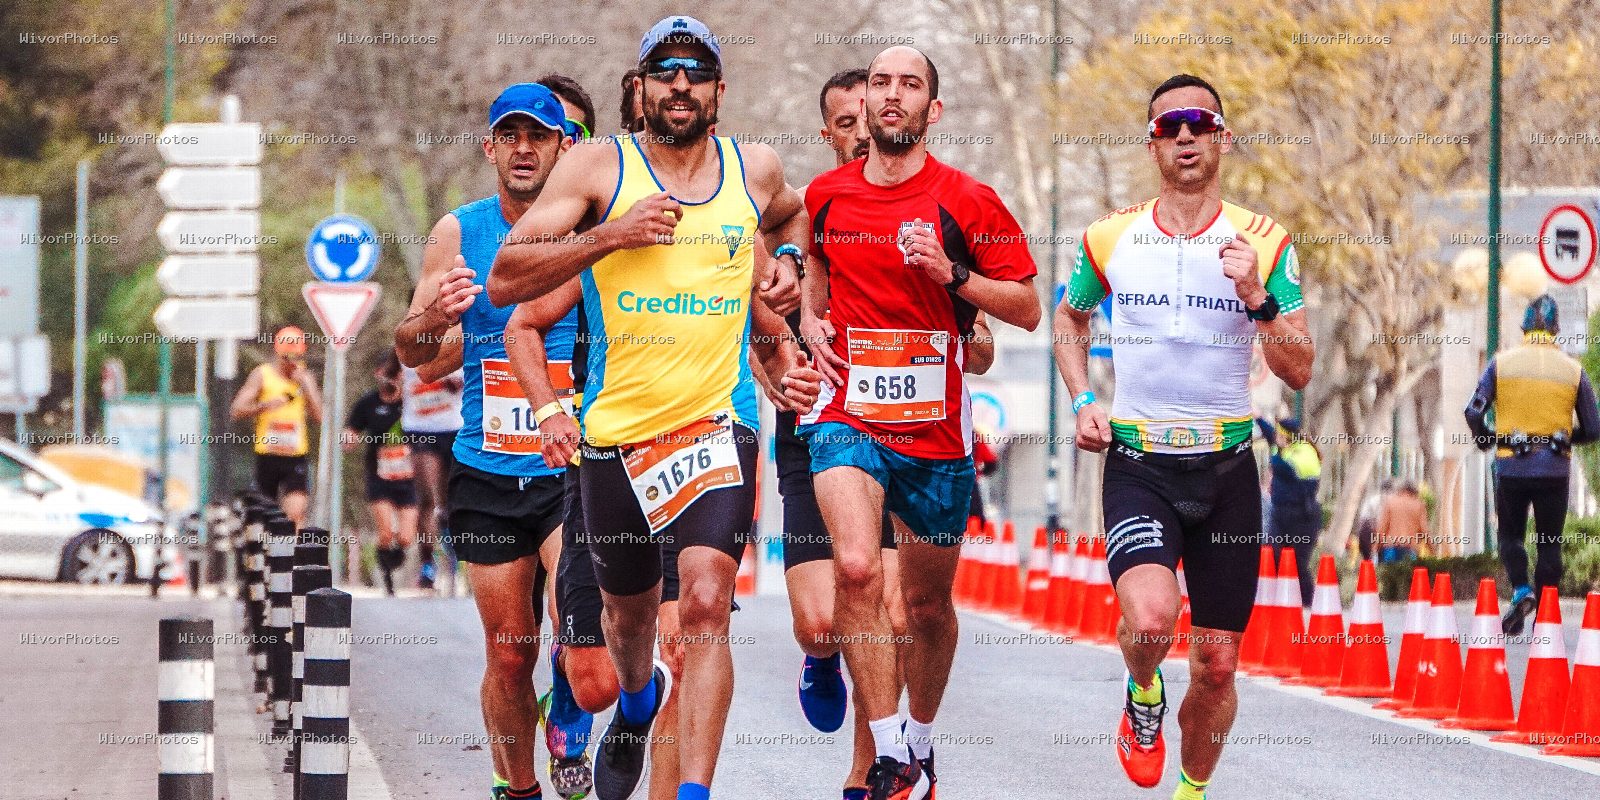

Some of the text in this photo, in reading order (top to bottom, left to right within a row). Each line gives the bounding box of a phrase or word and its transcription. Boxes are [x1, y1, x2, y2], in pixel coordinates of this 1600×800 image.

[1117, 293, 1247, 314] SFRAA TRIATL
[874, 375, 917, 400] 658
[657, 447, 712, 496] 1676
